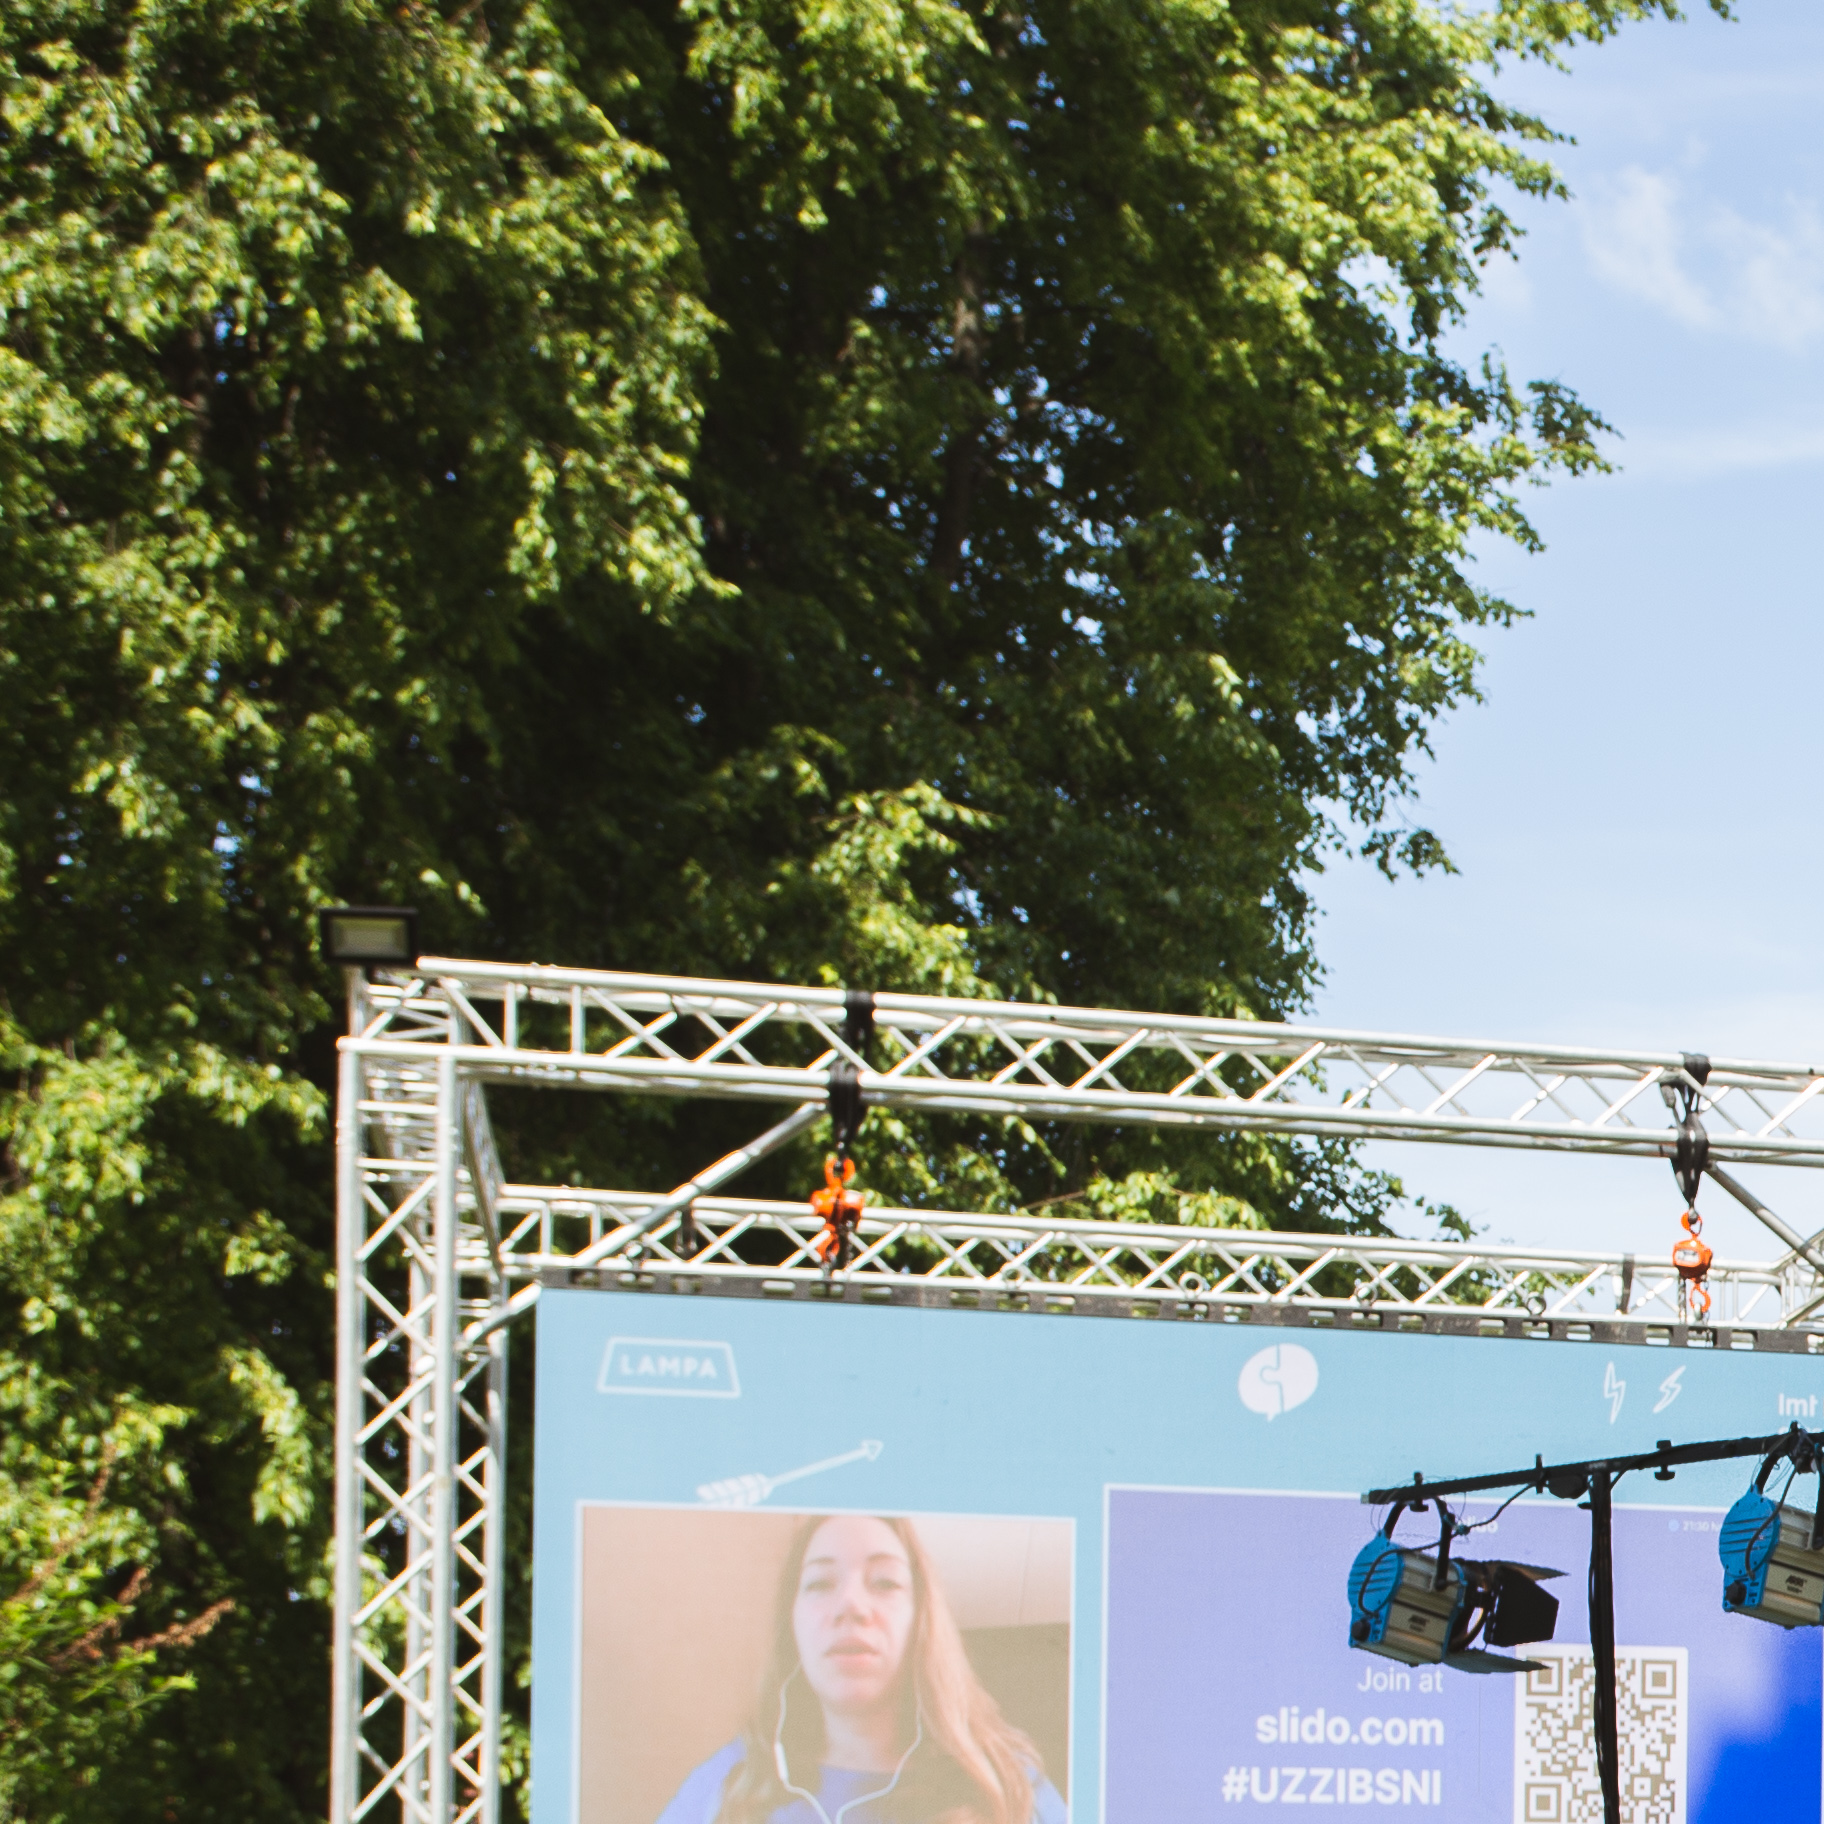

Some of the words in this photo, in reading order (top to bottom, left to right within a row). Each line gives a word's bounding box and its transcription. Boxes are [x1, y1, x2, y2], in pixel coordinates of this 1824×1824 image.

[619, 1353, 717, 1378] LAMPA
[1357, 1666, 1411, 1692] Join
[1418, 1669, 1444, 1693] at
[1256, 1705, 1445, 1746] slido.com
[1222, 1766, 1442, 1805] #UZZIBSNI
